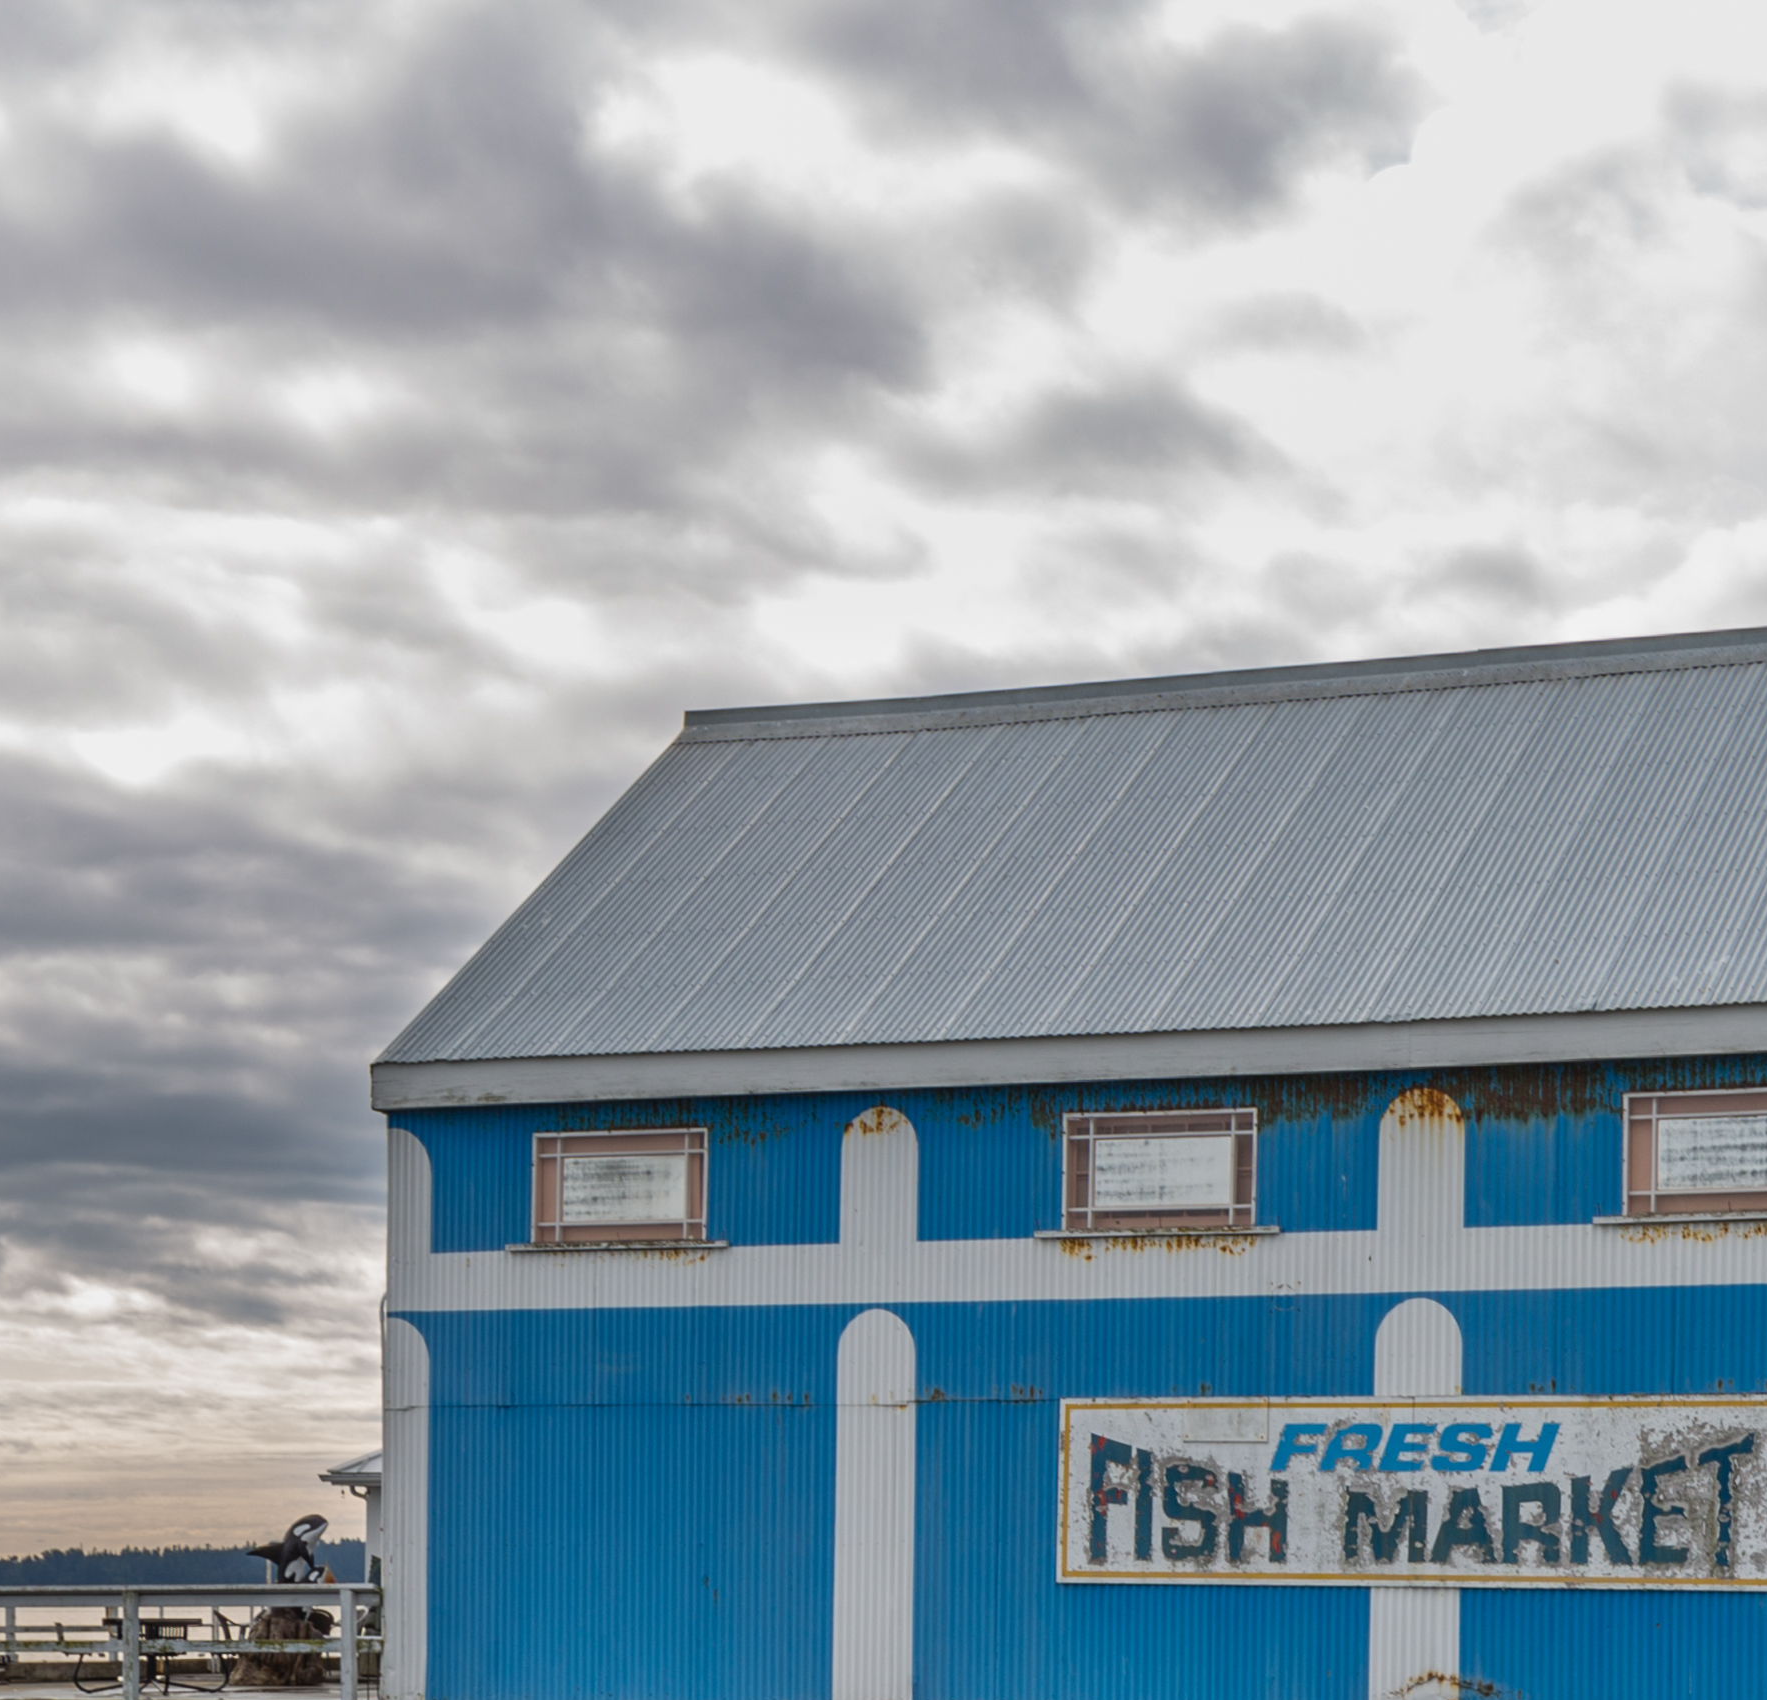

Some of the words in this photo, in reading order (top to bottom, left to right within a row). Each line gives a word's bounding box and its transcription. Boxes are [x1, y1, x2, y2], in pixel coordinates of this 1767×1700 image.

[1268, 1422, 1561, 1473] FRESH
[1088, 1431, 1289, 1564] FISH
[1343, 1431, 1756, 1567] MARKET
